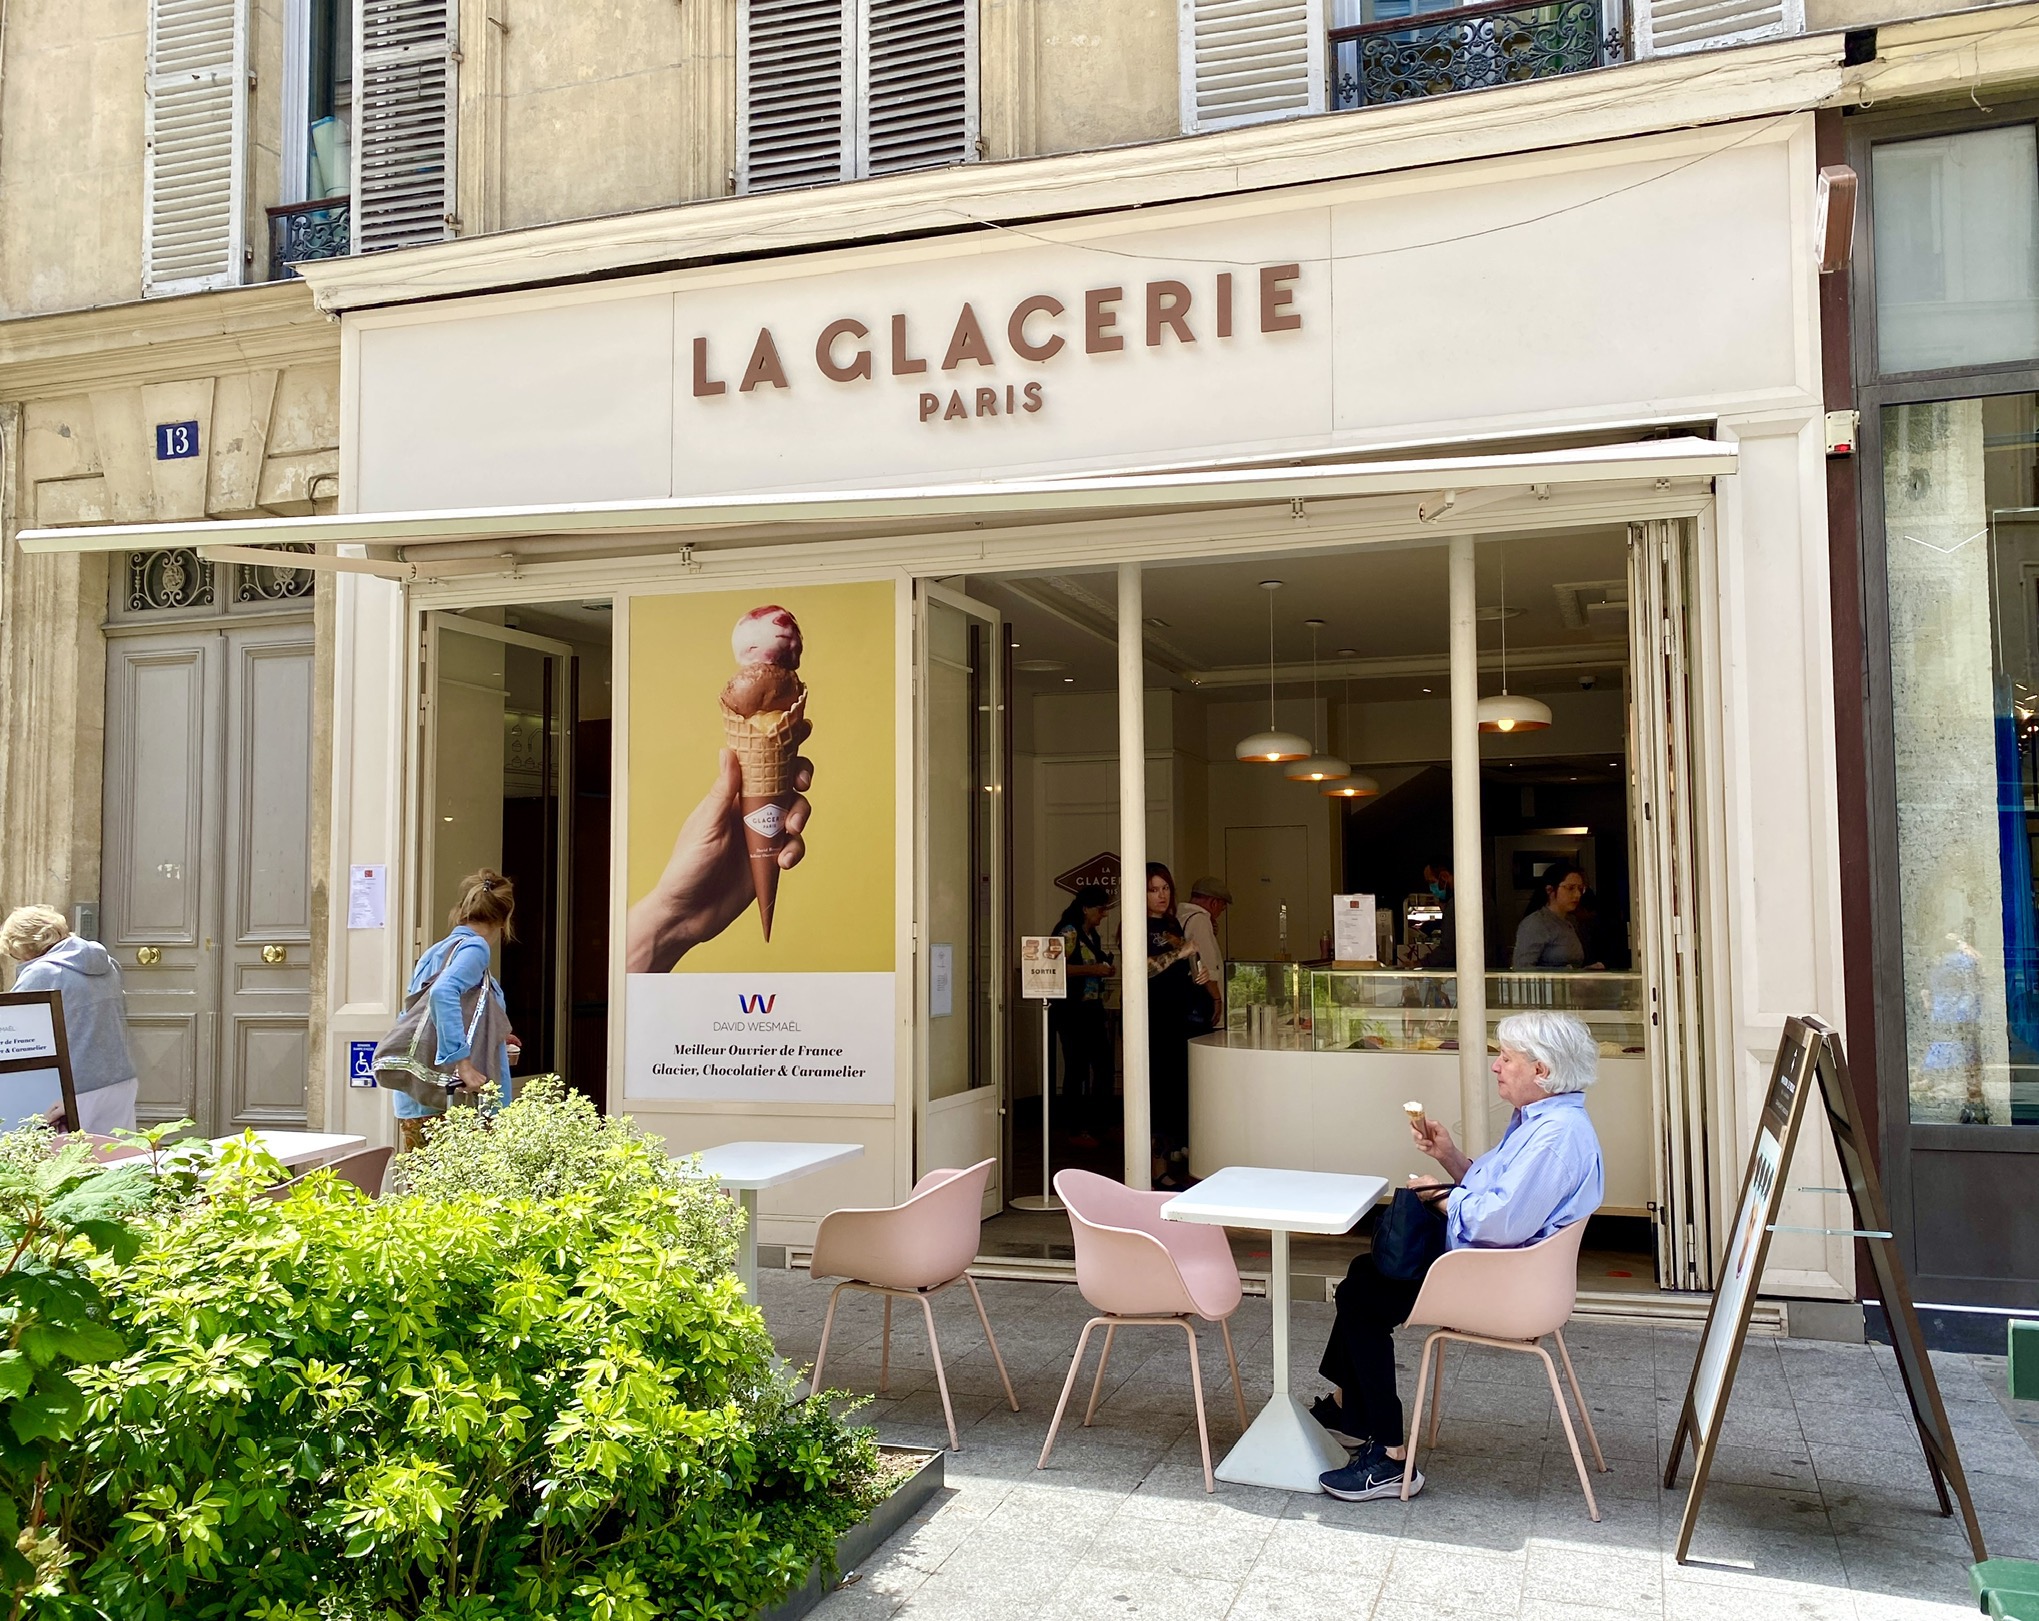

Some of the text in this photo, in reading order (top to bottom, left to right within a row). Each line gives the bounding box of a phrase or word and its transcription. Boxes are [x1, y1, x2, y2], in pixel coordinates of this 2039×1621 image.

[693, 263, 1301, 397] LA GLACERIE
[919, 381, 1044, 423] PARIS
[165, 426, 189, 456] 13
[1075, 876, 1121, 886] GLACE
[713, 1021, 746, 1032] DAVID
[11, 1044, 47, 1053] Caramelier
[673, 1044, 843, 1057] Meilleur Ouvrier de France
[652, 1063, 866, 1078] Glacier, Chocolatier & Caramelier
